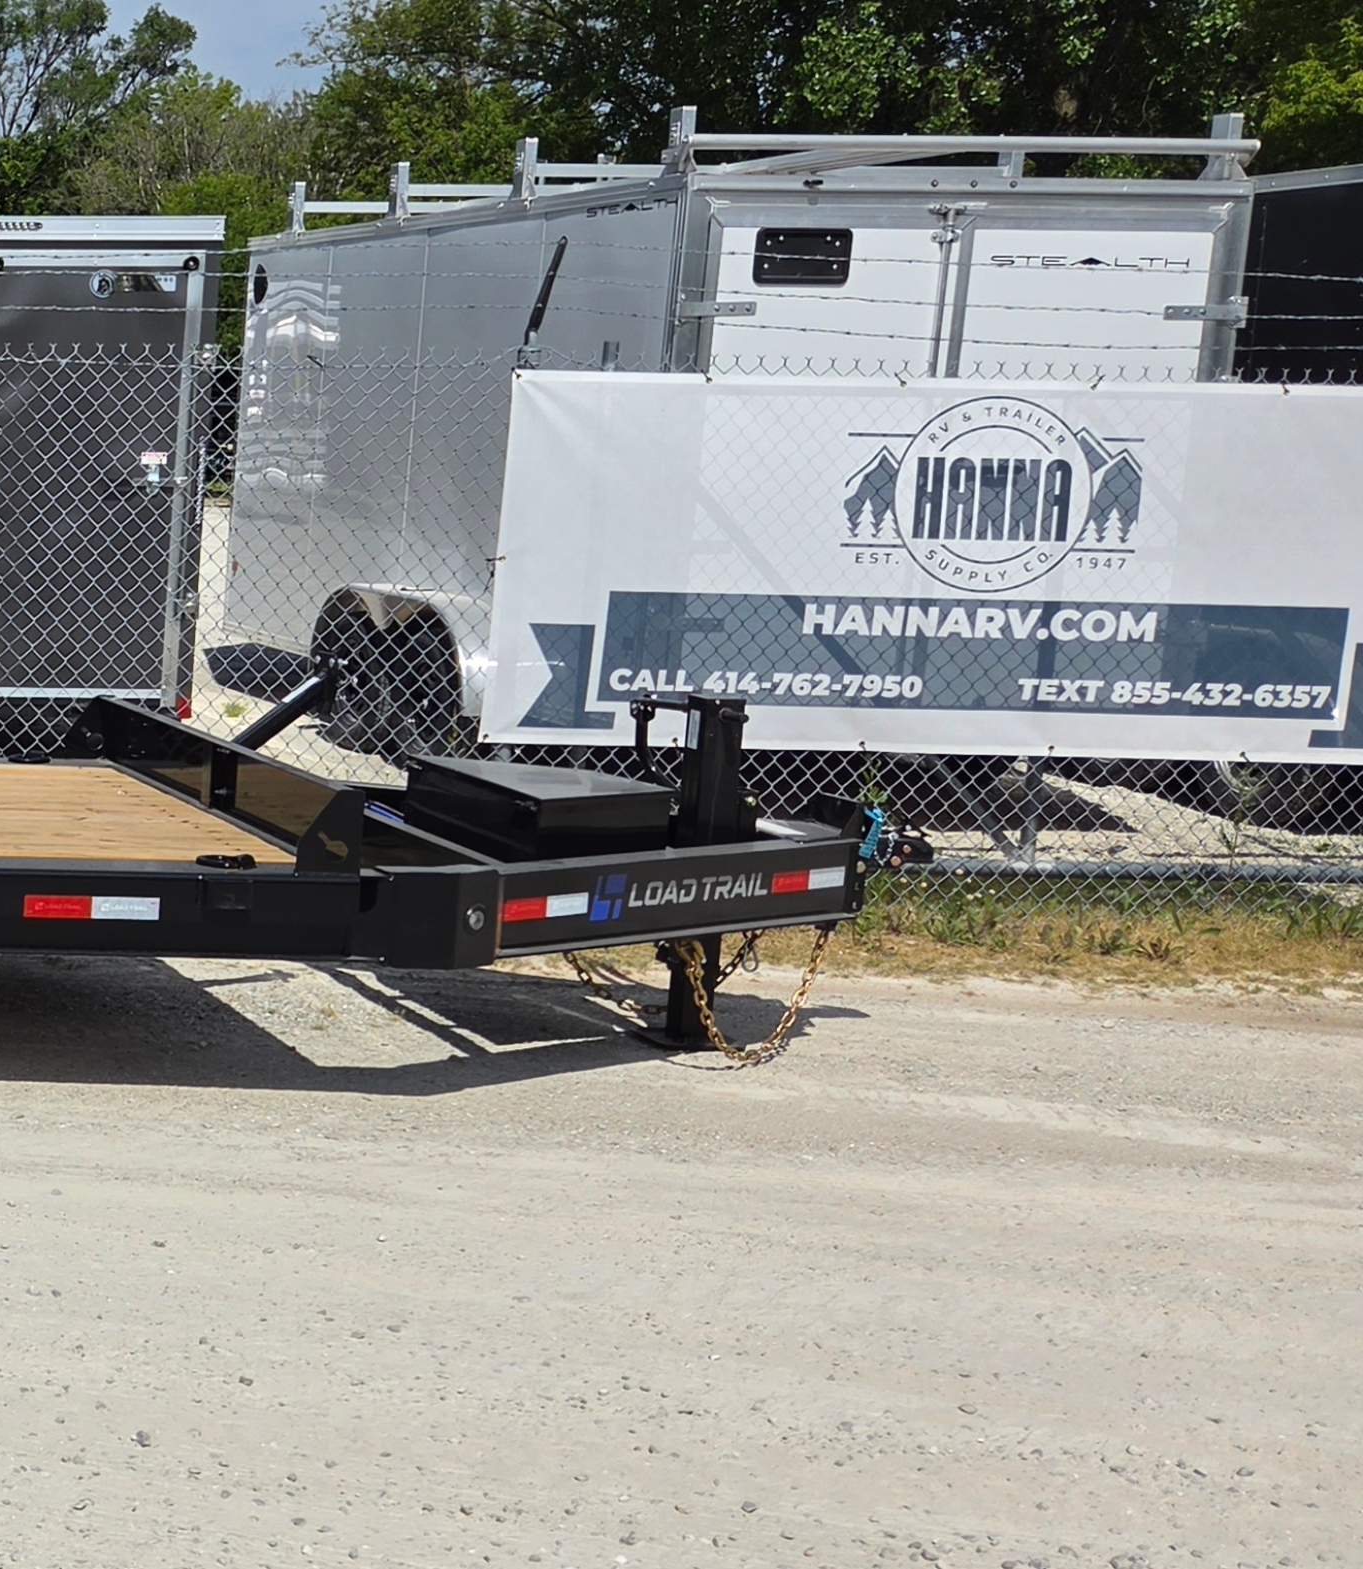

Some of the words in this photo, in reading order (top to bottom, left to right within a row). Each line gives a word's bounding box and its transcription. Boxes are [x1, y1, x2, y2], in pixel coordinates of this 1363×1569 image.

[990, 254, 1191, 269] STEALTH
[927, 421, 950, 445] RV
[961, 410, 973, 423] &
[983, 406, 1067, 446] TRAILER
[911, 456, 1074, 543] HANNA
[854, 552, 901, 566] EST.
[924, 549, 1008, 583] SUPPLY
[1022, 550, 1054, 574] CO.
[1075, 557, 1128, 571] 1947
[801, 602, 1158, 643] HANNARV.COM
[608, 667, 695, 693] CALL
[702, 670, 924, 699] 414-762-7950
[1017, 678, 1105, 702] TEXT
[1110, 680, 1332, 709] 855-432-6357
[627, 879, 698, 908] LOAD
[701, 871, 769, 902] TRAIL
